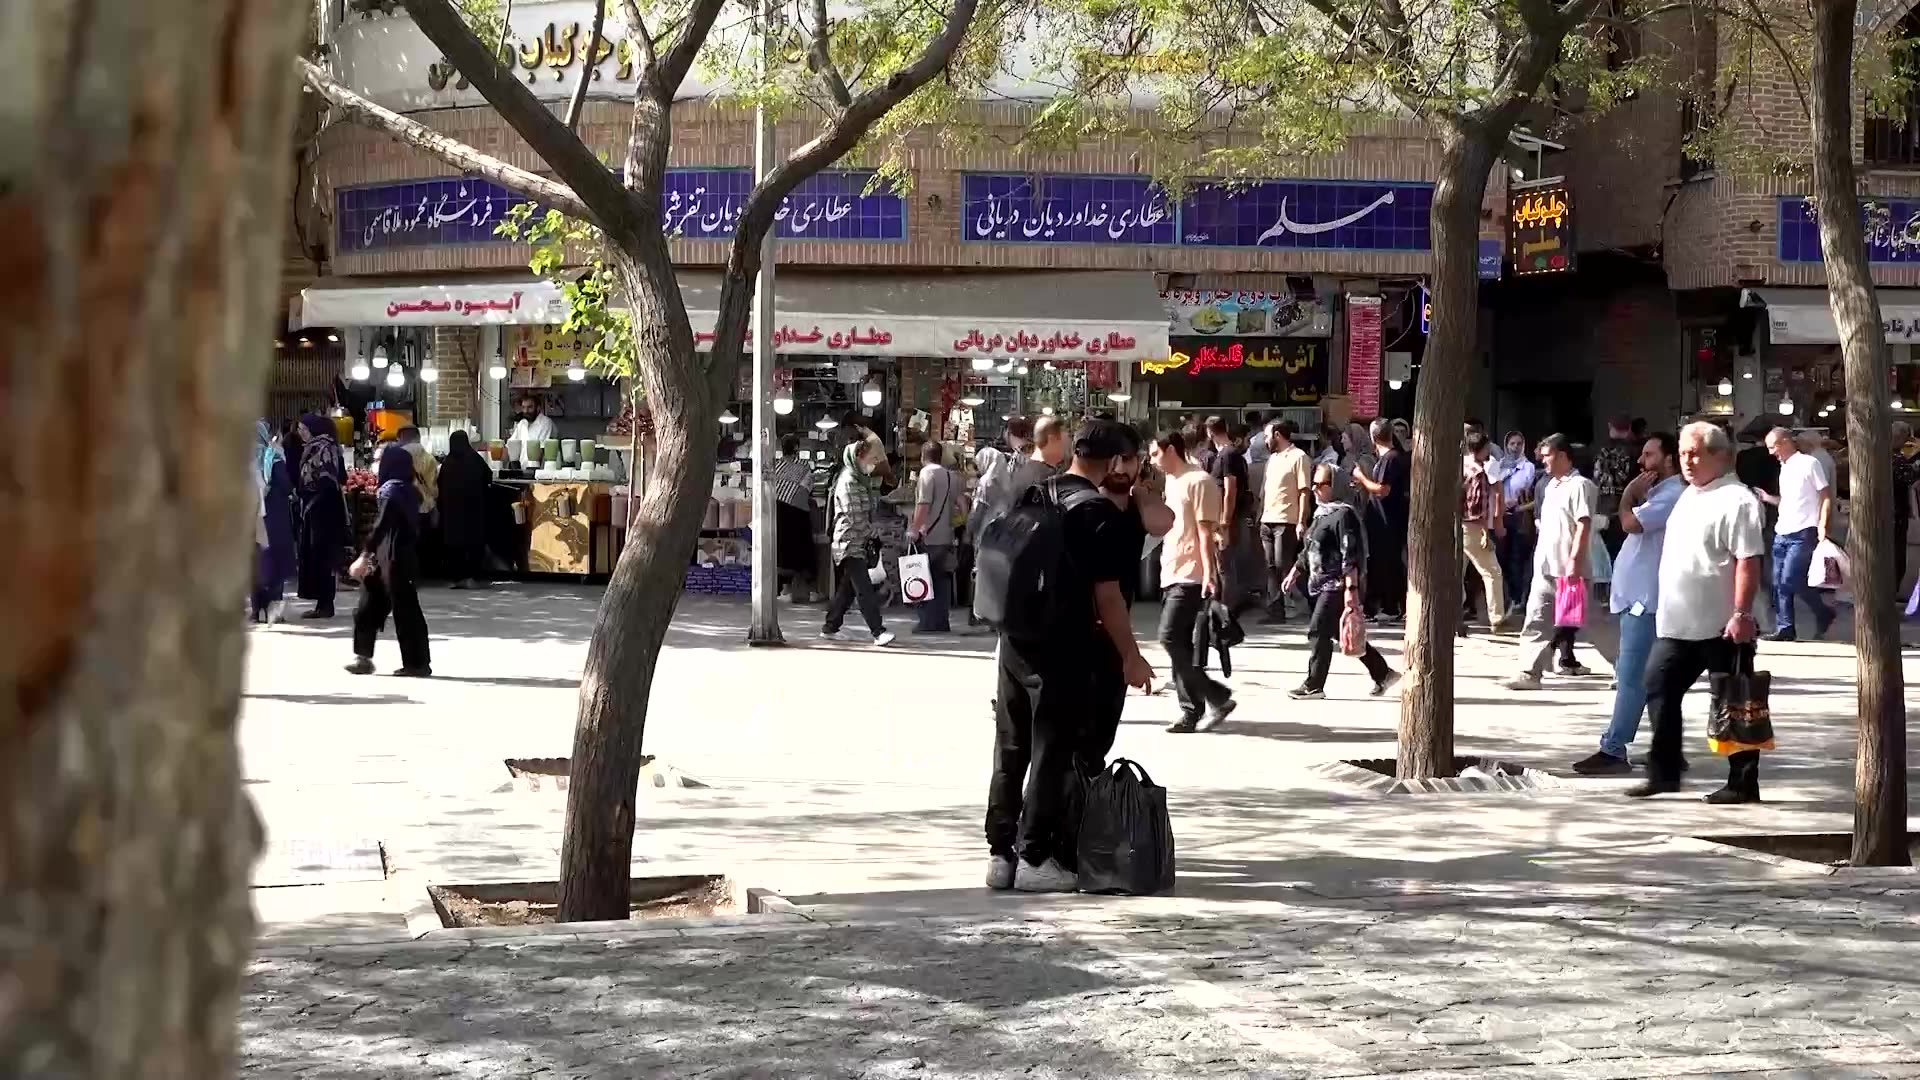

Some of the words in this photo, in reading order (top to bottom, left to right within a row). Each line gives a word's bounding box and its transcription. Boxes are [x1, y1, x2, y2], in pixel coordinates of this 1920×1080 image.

[403, 196, 428, 232] محمود
[427, 182, 493, 230] فروشگاه
[662, 187, 706, 231] تفرشی
[791, 196, 852, 232] عطاری
[976, 193, 1020, 239] دریانی
[1023, 201, 1107, 238] خداوردیان
[1258, 190, 1395, 246] مسلم
[1515, 194, 1566, 229] چلوکباب
[387, 299, 452, 318] محسن
[455, 291, 523, 316] آبمیوه
[827, 326, 893, 349] عطاری
[953, 329, 1003, 352] دریانی
[1005, 330, 1083, 354] خداوردیان
[1086, 331, 1137, 354] عطاری
[1245, 344, 1284, 368] شله
[1285, 343, 1317, 374] آش
